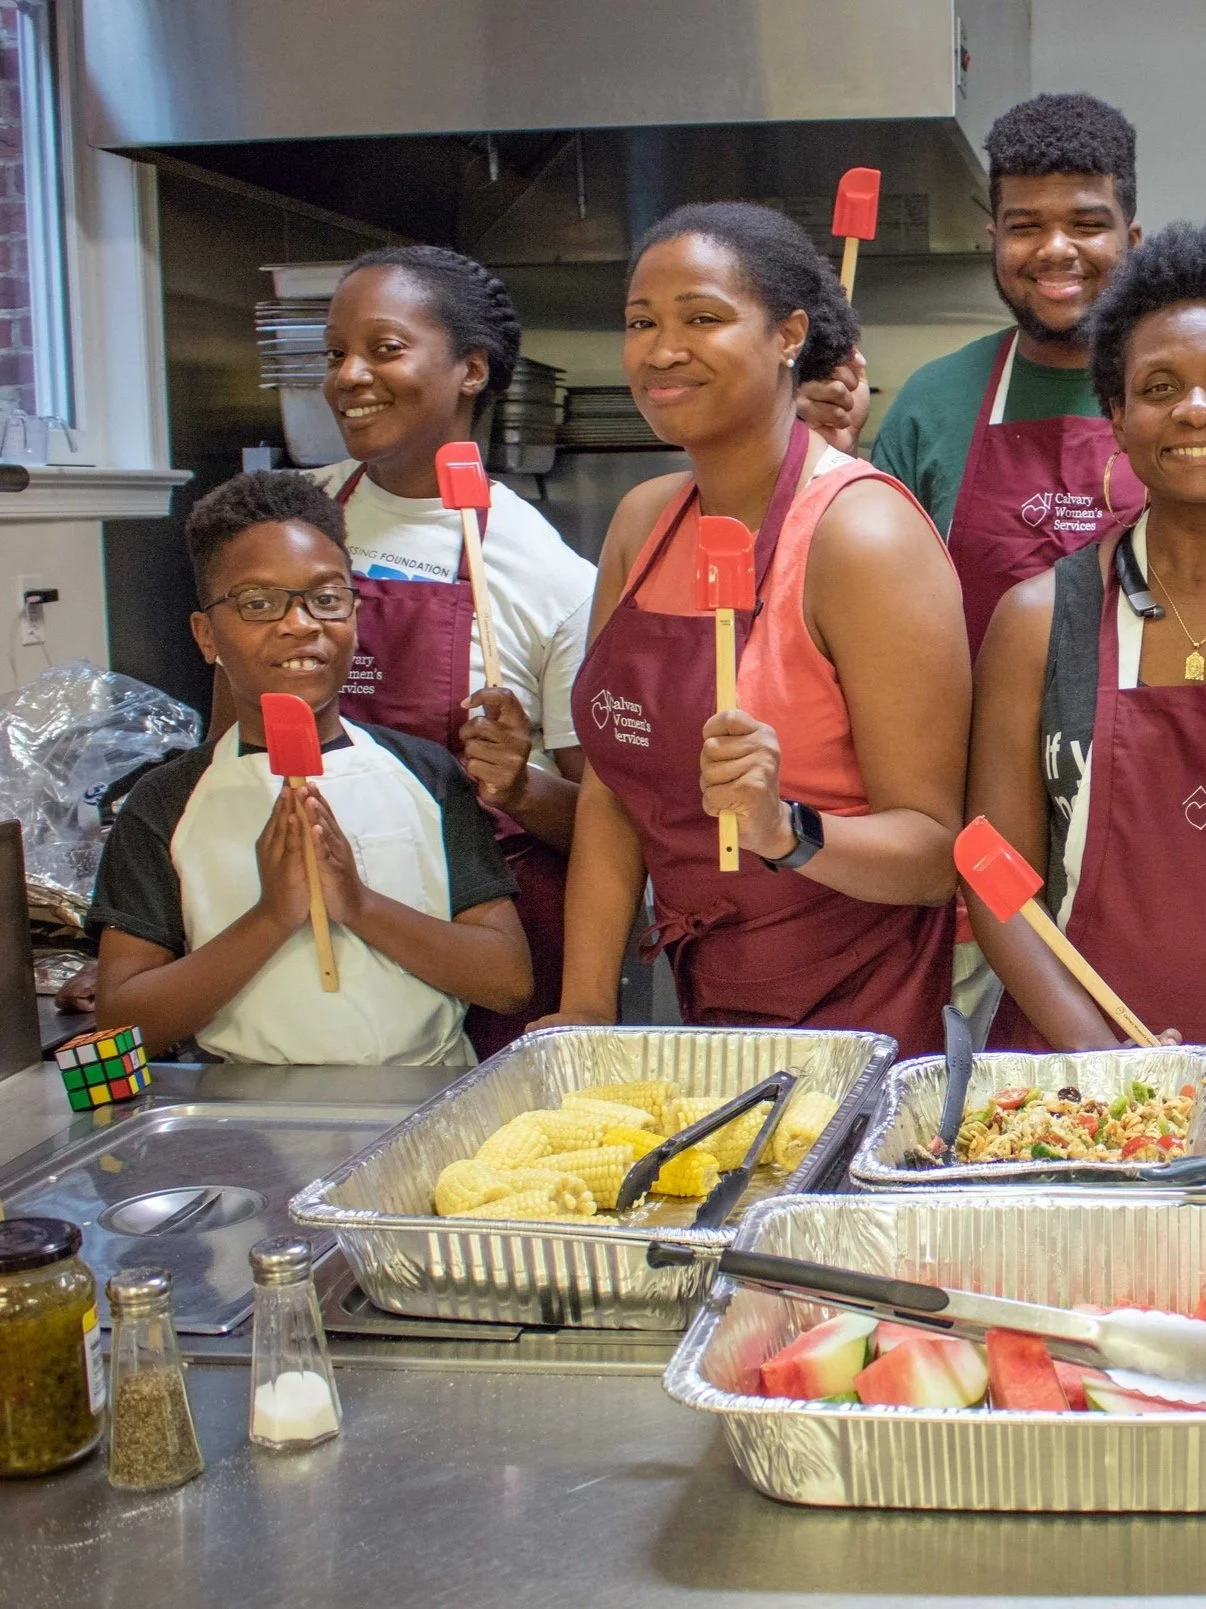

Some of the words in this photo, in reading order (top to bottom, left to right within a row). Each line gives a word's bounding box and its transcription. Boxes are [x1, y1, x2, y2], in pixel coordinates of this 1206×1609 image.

[1055, 492, 1093, 507] Calvary
[1055, 506, 1103, 519] Women's
[1053, 519, 1096, 531] Services
[349, 545, 378, 559] SSING
[380, 552, 450, 577] FOUNDATION
[347, 667, 383, 680] men's
[337, 681, 376, 694] rvices
[611, 696, 642, 716] alvary
